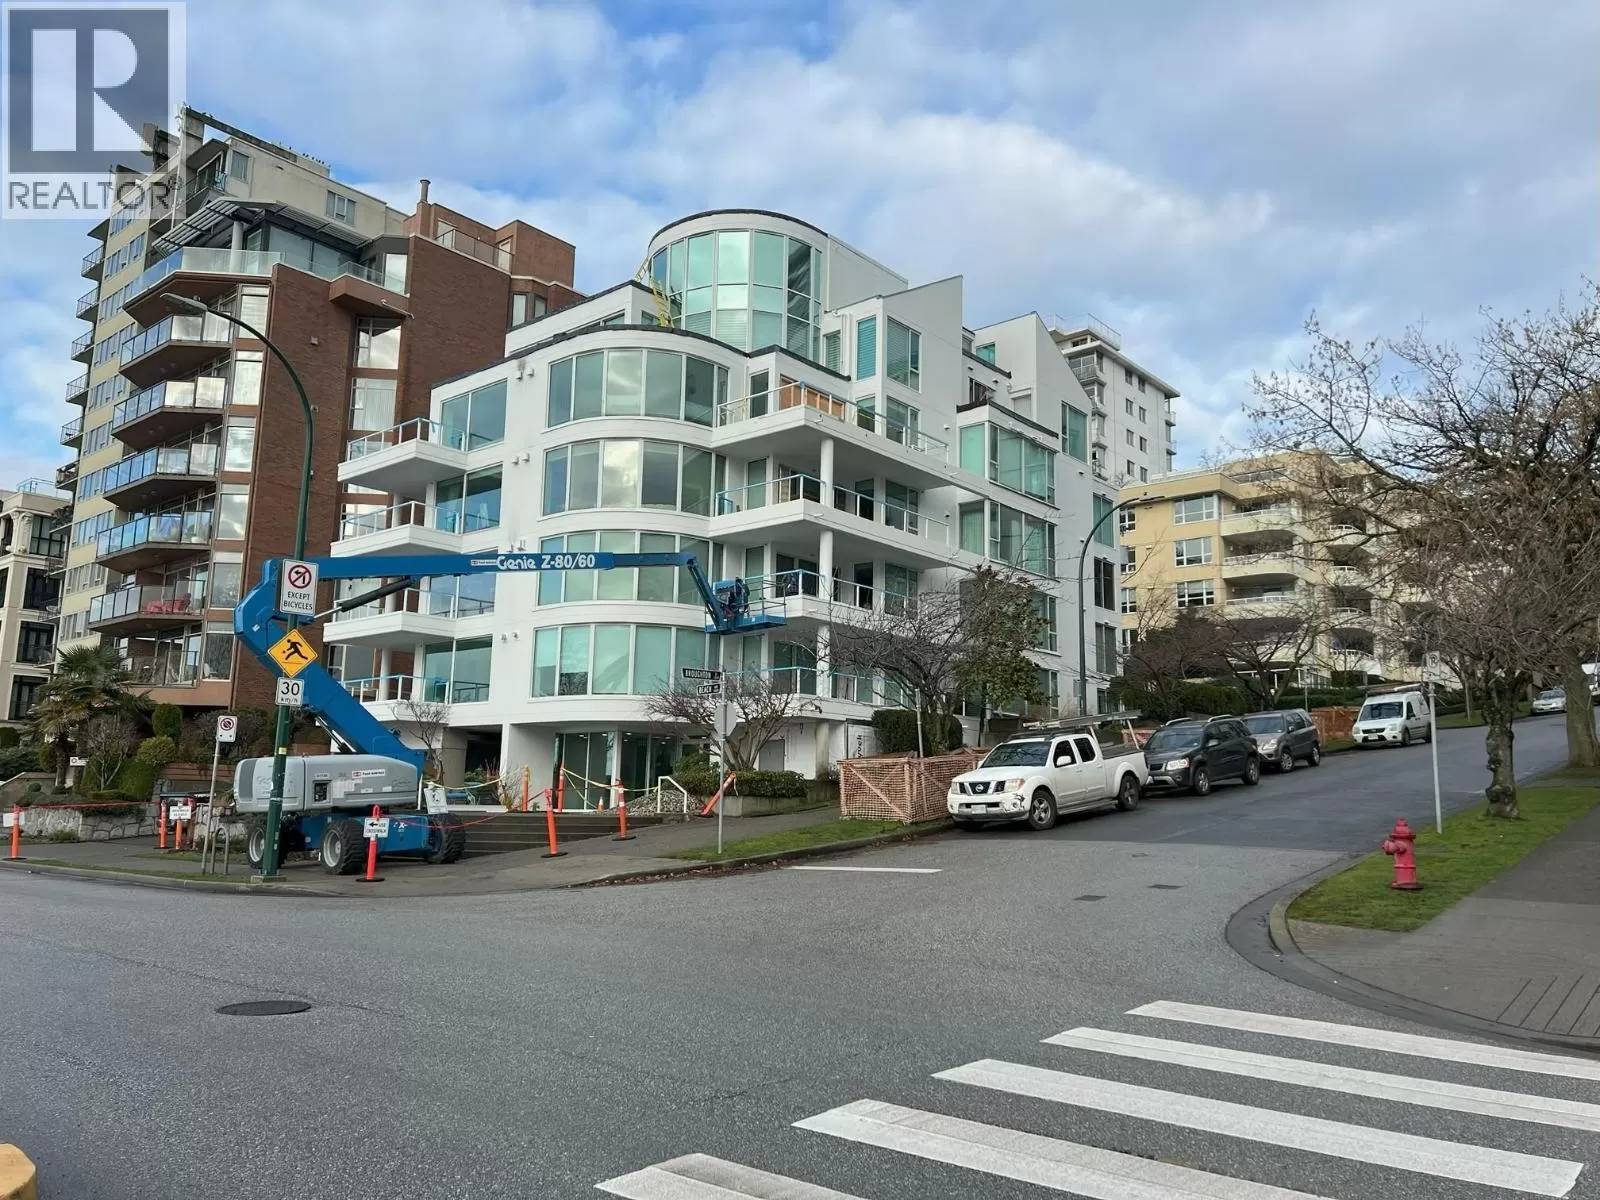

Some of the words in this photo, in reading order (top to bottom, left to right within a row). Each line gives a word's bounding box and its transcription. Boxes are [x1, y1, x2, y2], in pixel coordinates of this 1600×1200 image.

[497, 555, 537, 570] Genie
[541, 553, 596, 569] Z-80/60
[287, 591, 311, 600] EXCEPT
[283, 600, 313, 610] BICYCLES
[281, 681, 300, 695] 30
